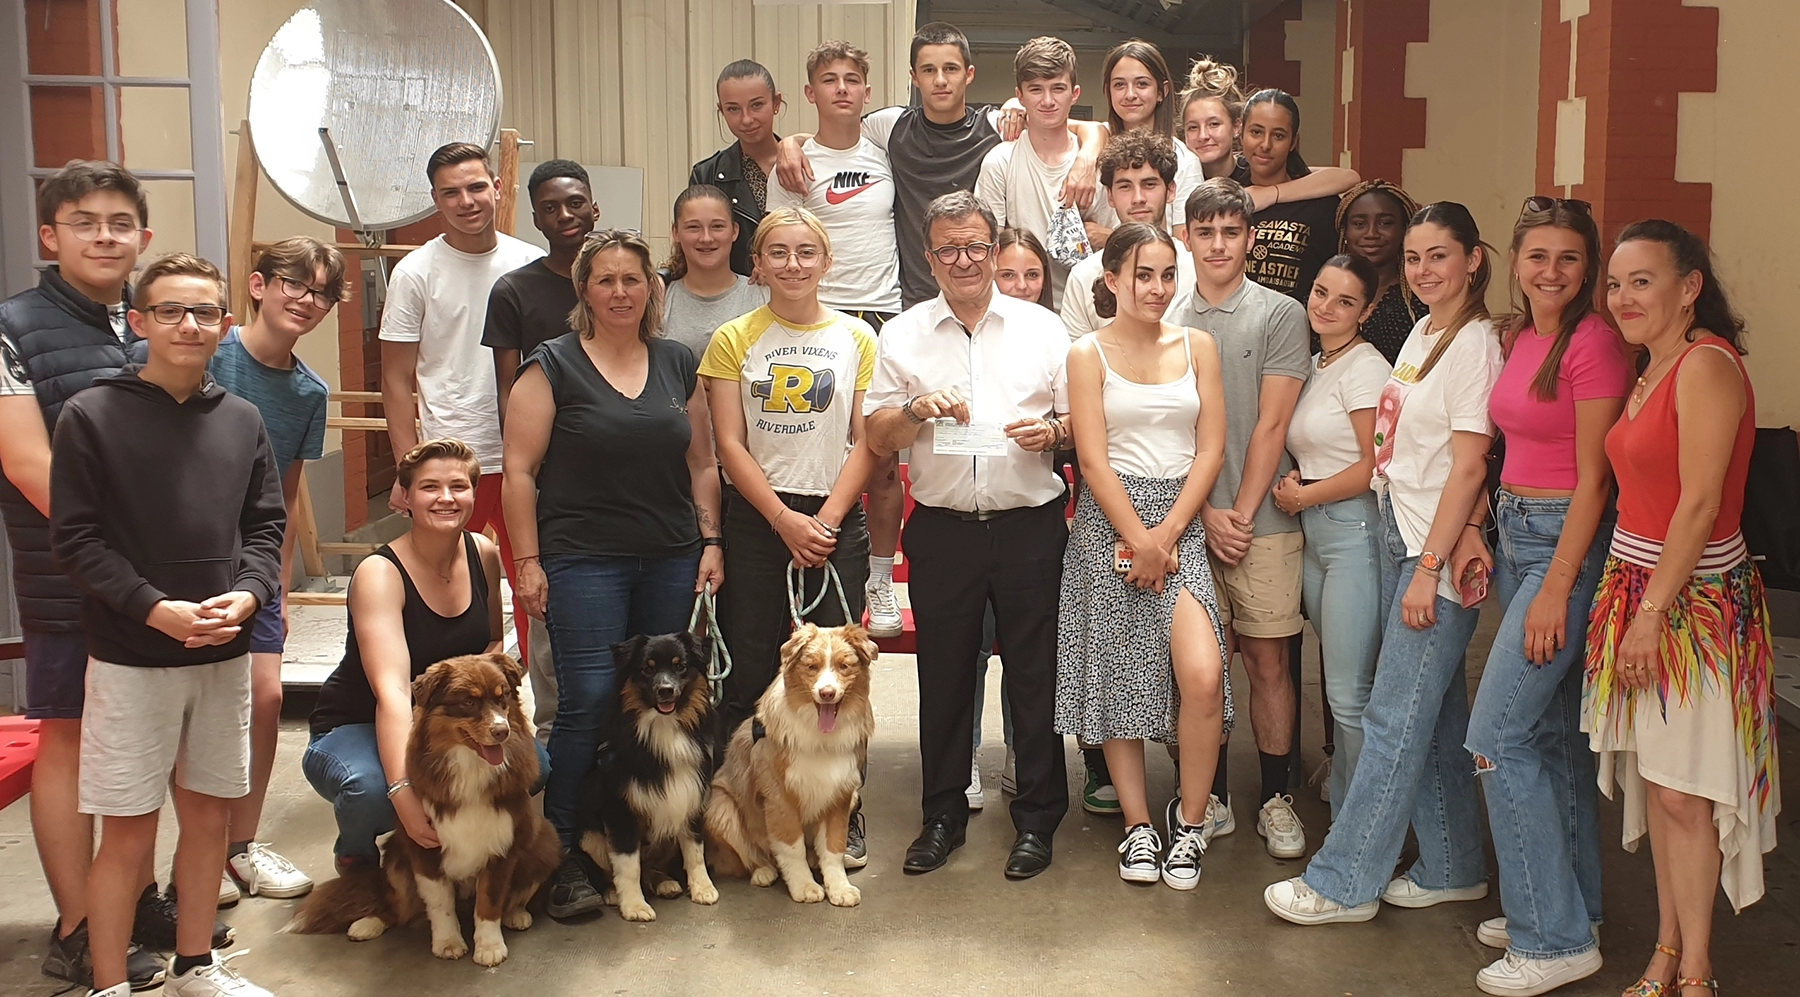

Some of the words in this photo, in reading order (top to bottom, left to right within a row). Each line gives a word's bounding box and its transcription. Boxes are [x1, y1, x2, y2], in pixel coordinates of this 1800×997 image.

[833, 171, 871, 188] NIKE
[1256, 220, 1310, 236] SAVASTA
[1254, 228, 1309, 247] ETBALL
[764, 346, 797, 362] RIVER
[802, 346, 838, 360] VIXENS
[762, 363, 815, 413] R
[756, 418, 816, 434] RIVERDALE
